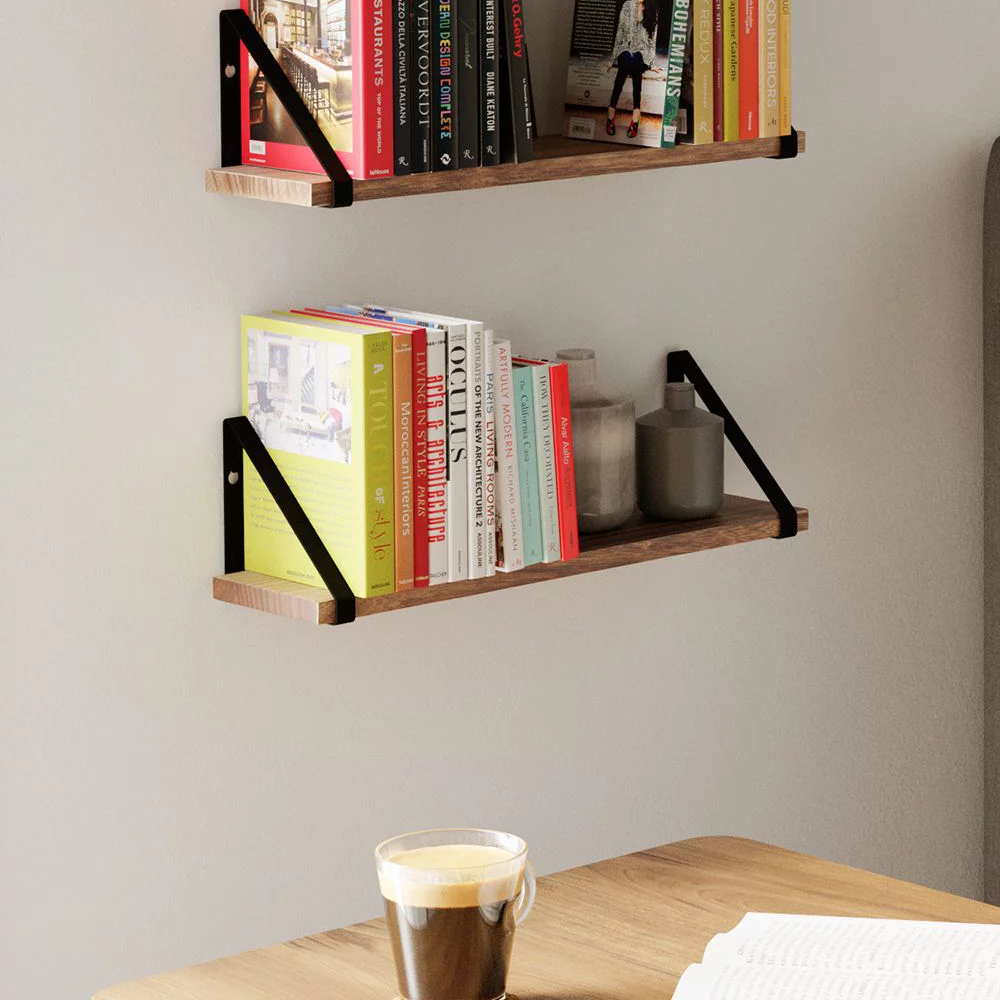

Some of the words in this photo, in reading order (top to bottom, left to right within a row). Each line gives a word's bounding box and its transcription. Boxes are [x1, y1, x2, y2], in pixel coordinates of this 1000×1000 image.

[511, 4, 522, 17] O.
[398, 21, 406, 48] DELLA
[440, 32, 451, 75] DESIGN
[486, 38, 495, 60] BUILT
[513, 19, 524, 57] Gehry
[700, 10, 711, 64] REDUX
[399, 50, 408, 83] CIVILTÀ
[418, 1, 430, 128] VERVOORDT
[730, 41, 738, 81] Gardens
[767, 28, 777, 107] INTERIORS
[486, 72, 495, 96] DIANE
[376, 107, 382, 116] OF
[399, 85, 407, 125] ITALIANA
[441, 79, 452, 139] COMPLETE
[486, 99, 495, 131] KEATON
[374, 363, 385, 375] A
[474, 331, 482, 383] PORTRAITS
[499, 347, 511, 400] ARTFULLY
[416, 352, 426, 403] LIVING
[427, 375, 447, 409] arts
[474, 385, 482, 398] OF
[486, 373, 494, 414] PARIS
[540, 376, 548, 399] HOW
[417, 410, 426, 425] IN
[450, 346, 467, 463] OCULUS
[521, 395, 530, 439] California
[541, 404, 550, 430] THEY
[487, 421, 495, 467] LIVING
[503, 404, 513, 457] MODERN
[417, 430, 427, 477] STYLE
[523, 441, 531, 462] Casa
[543, 435, 553, 499] DECORATED
[562, 441, 571, 464] Aalto
[417, 485, 426, 517] PARIS
[427, 440, 448, 543] architecture
[475, 446, 483, 518] ARCHITECTURE
[487, 474, 495, 526] ROOMS
[507, 465, 515, 504] RICHARD
[369, 509, 391, 561] style
[510, 508, 518, 551] MISHAAN
